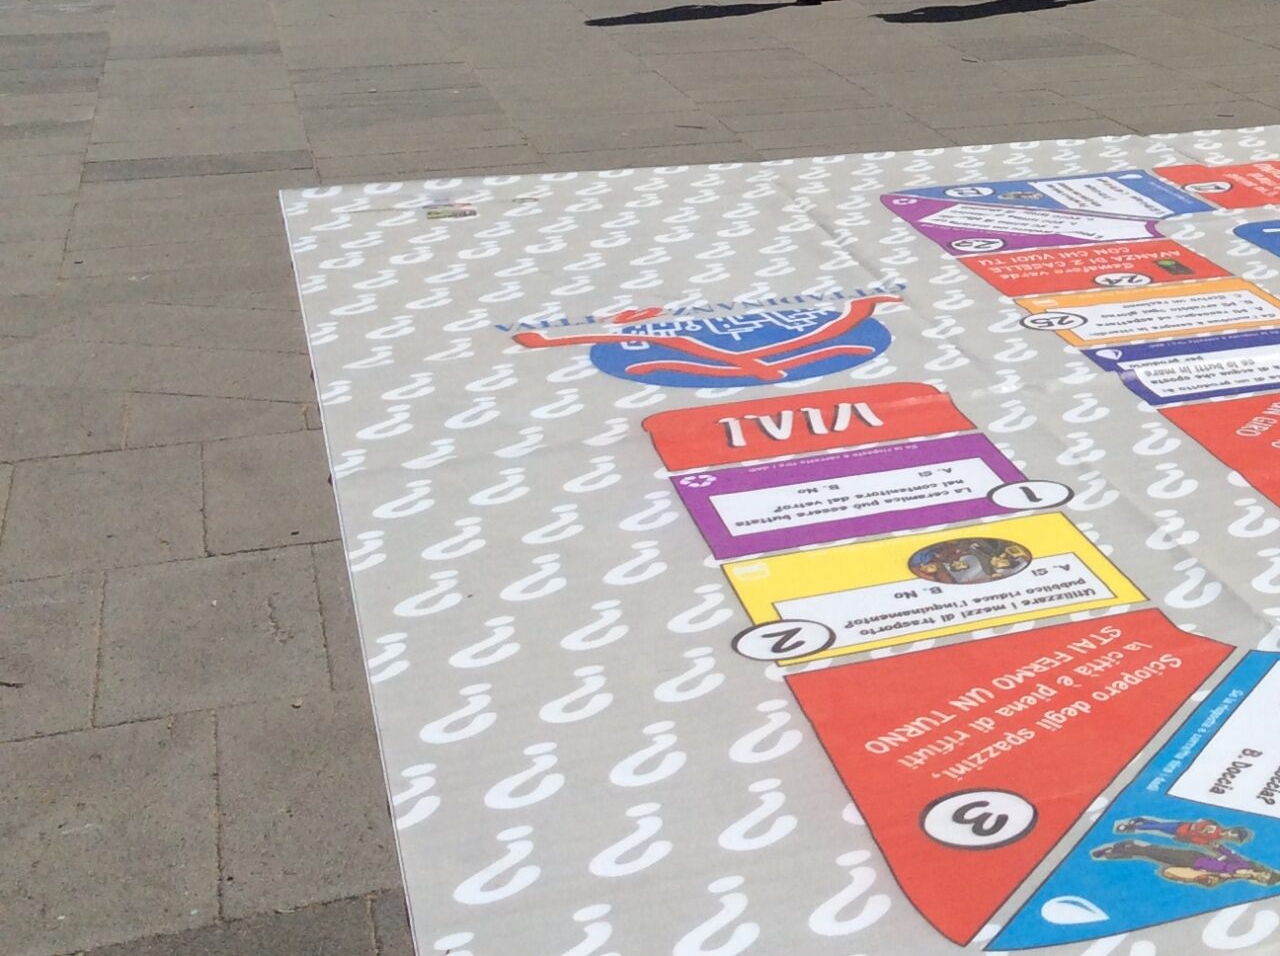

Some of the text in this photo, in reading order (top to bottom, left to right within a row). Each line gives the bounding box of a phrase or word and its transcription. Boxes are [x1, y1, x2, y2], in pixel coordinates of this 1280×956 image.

[977, 246, 1135, 267] CON CHI VUOI TU
[1107, 249, 1186, 264] AVANZA
[988, 260, 1070, 275] CASELLE
[998, 262, 1139, 280] Semaforo verde
[1103, 274, 1143, 285] 24
[1033, 315, 1073, 328] 25
[1235, 413, 1280, 442] GIRO
[937, 467, 954, 475] A.
[796, 487, 820, 496] No
[823, 484, 840, 492] B.
[1019, 486, 1042, 503] 1
[771, 479, 966, 514] nel contenitore del vetro?
[734, 487, 973, 531] La ceramica può essere buttata
[1053, 564, 1074, 573] A.
[892, 590, 920, 601] No
[922, 586, 944, 596] B.
[1020, 588, 1099, 608] Utilizzare
[839, 578, 1090, 630] pubblico riduce l'inquinamento?
[959, 604, 1010, 619] mezzi
[939, 613, 958, 622] di
[857, 616, 939, 638] trasporto
[761, 627, 806, 654] 2
[861, 624, 1128, 758] STAI FERMO UN TURNO
[1227, 689, 1245, 700] Se
[896, 639, 1154, 773] la città è piena di rifiuti
[1222, 698, 1238, 706] la
[927, 651, 1188, 790] Sciopero degli spazzini,
[1198, 703, 1231, 729] risposta
[1173, 733, 1206, 760] corretta
[1237, 748, 1264, 762] B.
[1162, 759, 1186, 775] tira
[1145, 777, 1169, 792] dadi
[1208, 761, 1254, 797] Doccia
[952, 800, 1008, 838] 3
